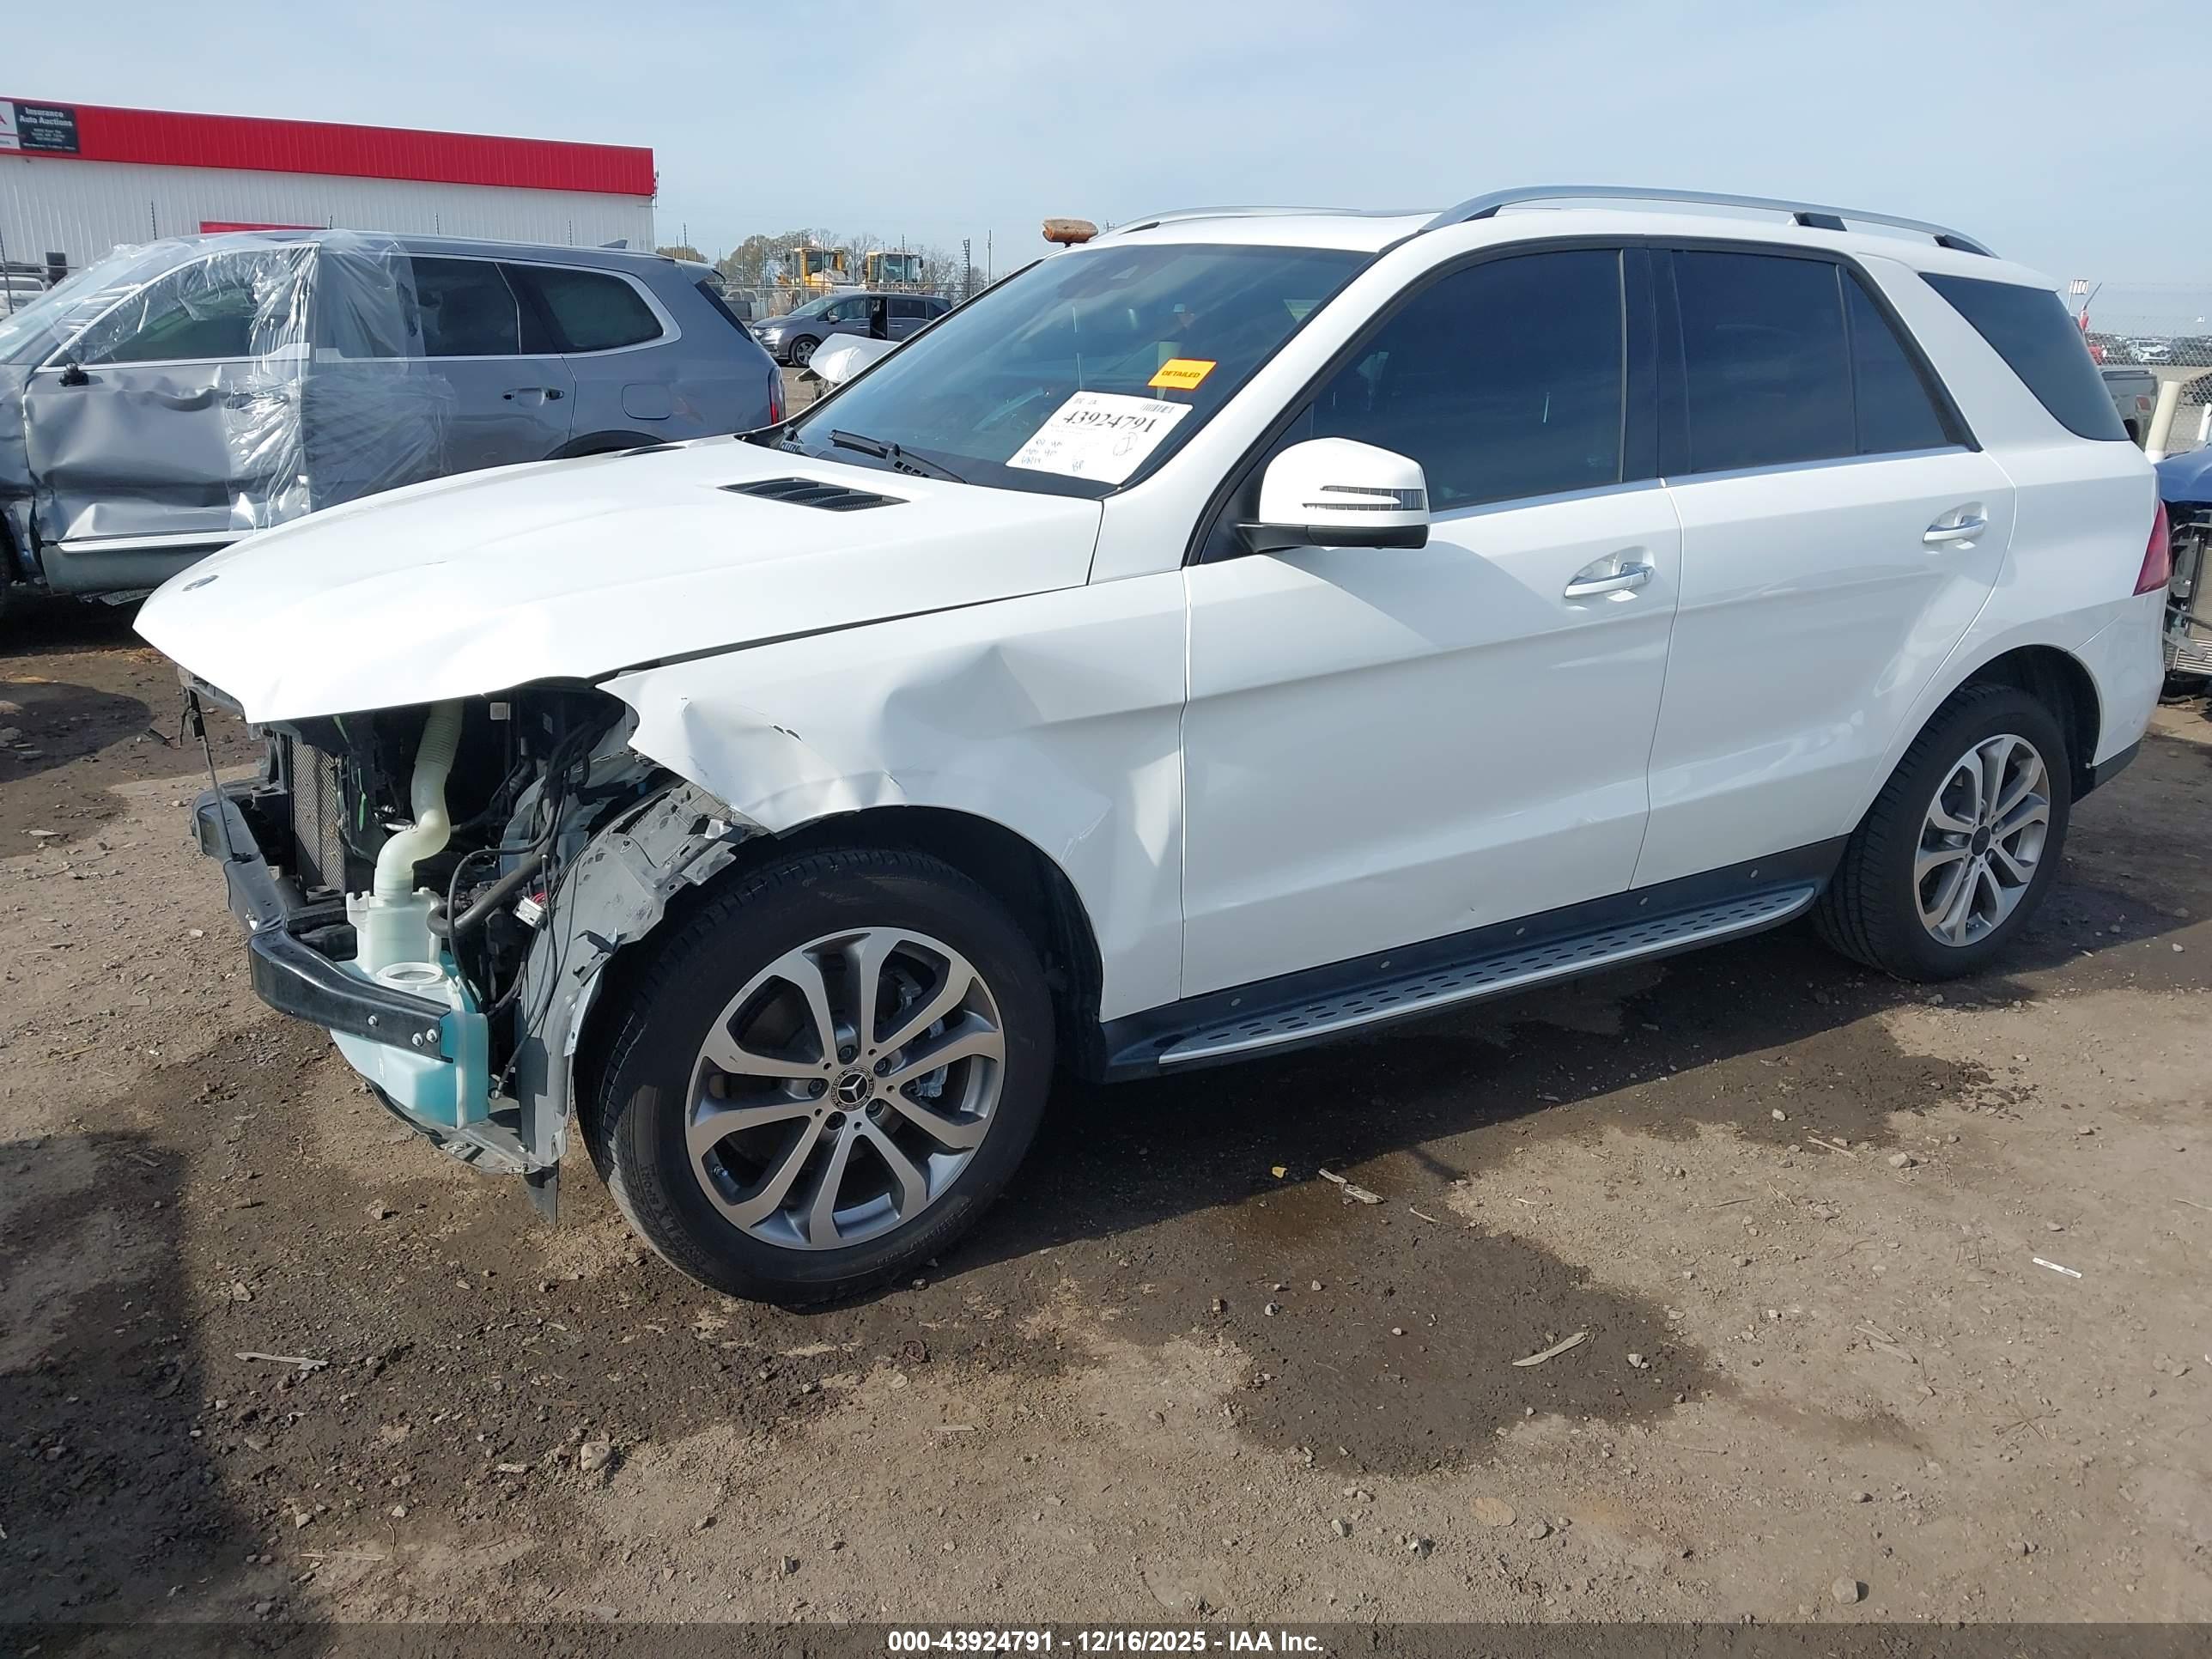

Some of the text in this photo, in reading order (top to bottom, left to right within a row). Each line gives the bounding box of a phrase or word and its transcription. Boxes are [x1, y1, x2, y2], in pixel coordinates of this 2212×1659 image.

[25, 106, 64, 118] Insurance
[19, 114, 38, 124] Auto
[39, 117, 73, 126] Auctions
[1161, 370, 1200, 379] DETAILED
[1063, 410, 1158, 433] 43924791
